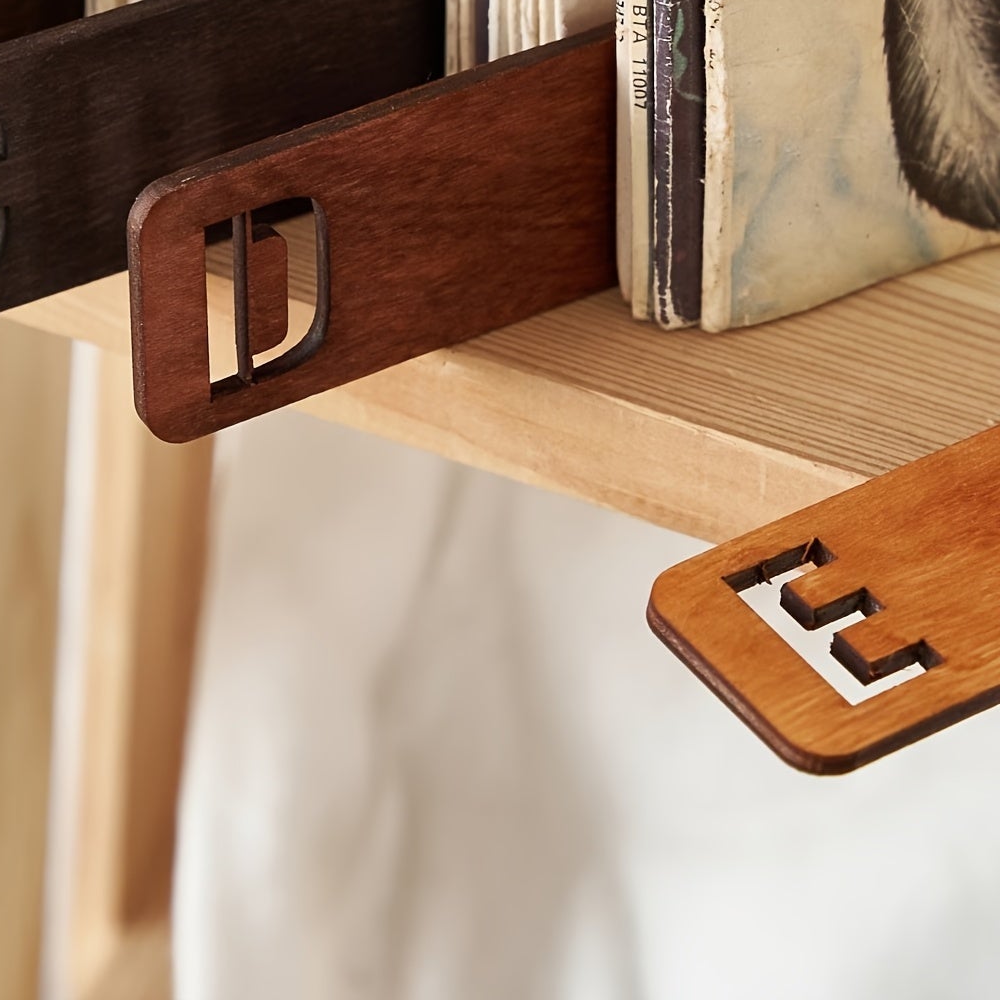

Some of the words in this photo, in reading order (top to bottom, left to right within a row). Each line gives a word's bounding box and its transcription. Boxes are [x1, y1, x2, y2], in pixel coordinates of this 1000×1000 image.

[631, 58, 648, 110] 11007
[204, 196, 331, 402] D
[721, 537, 943, 706] E
